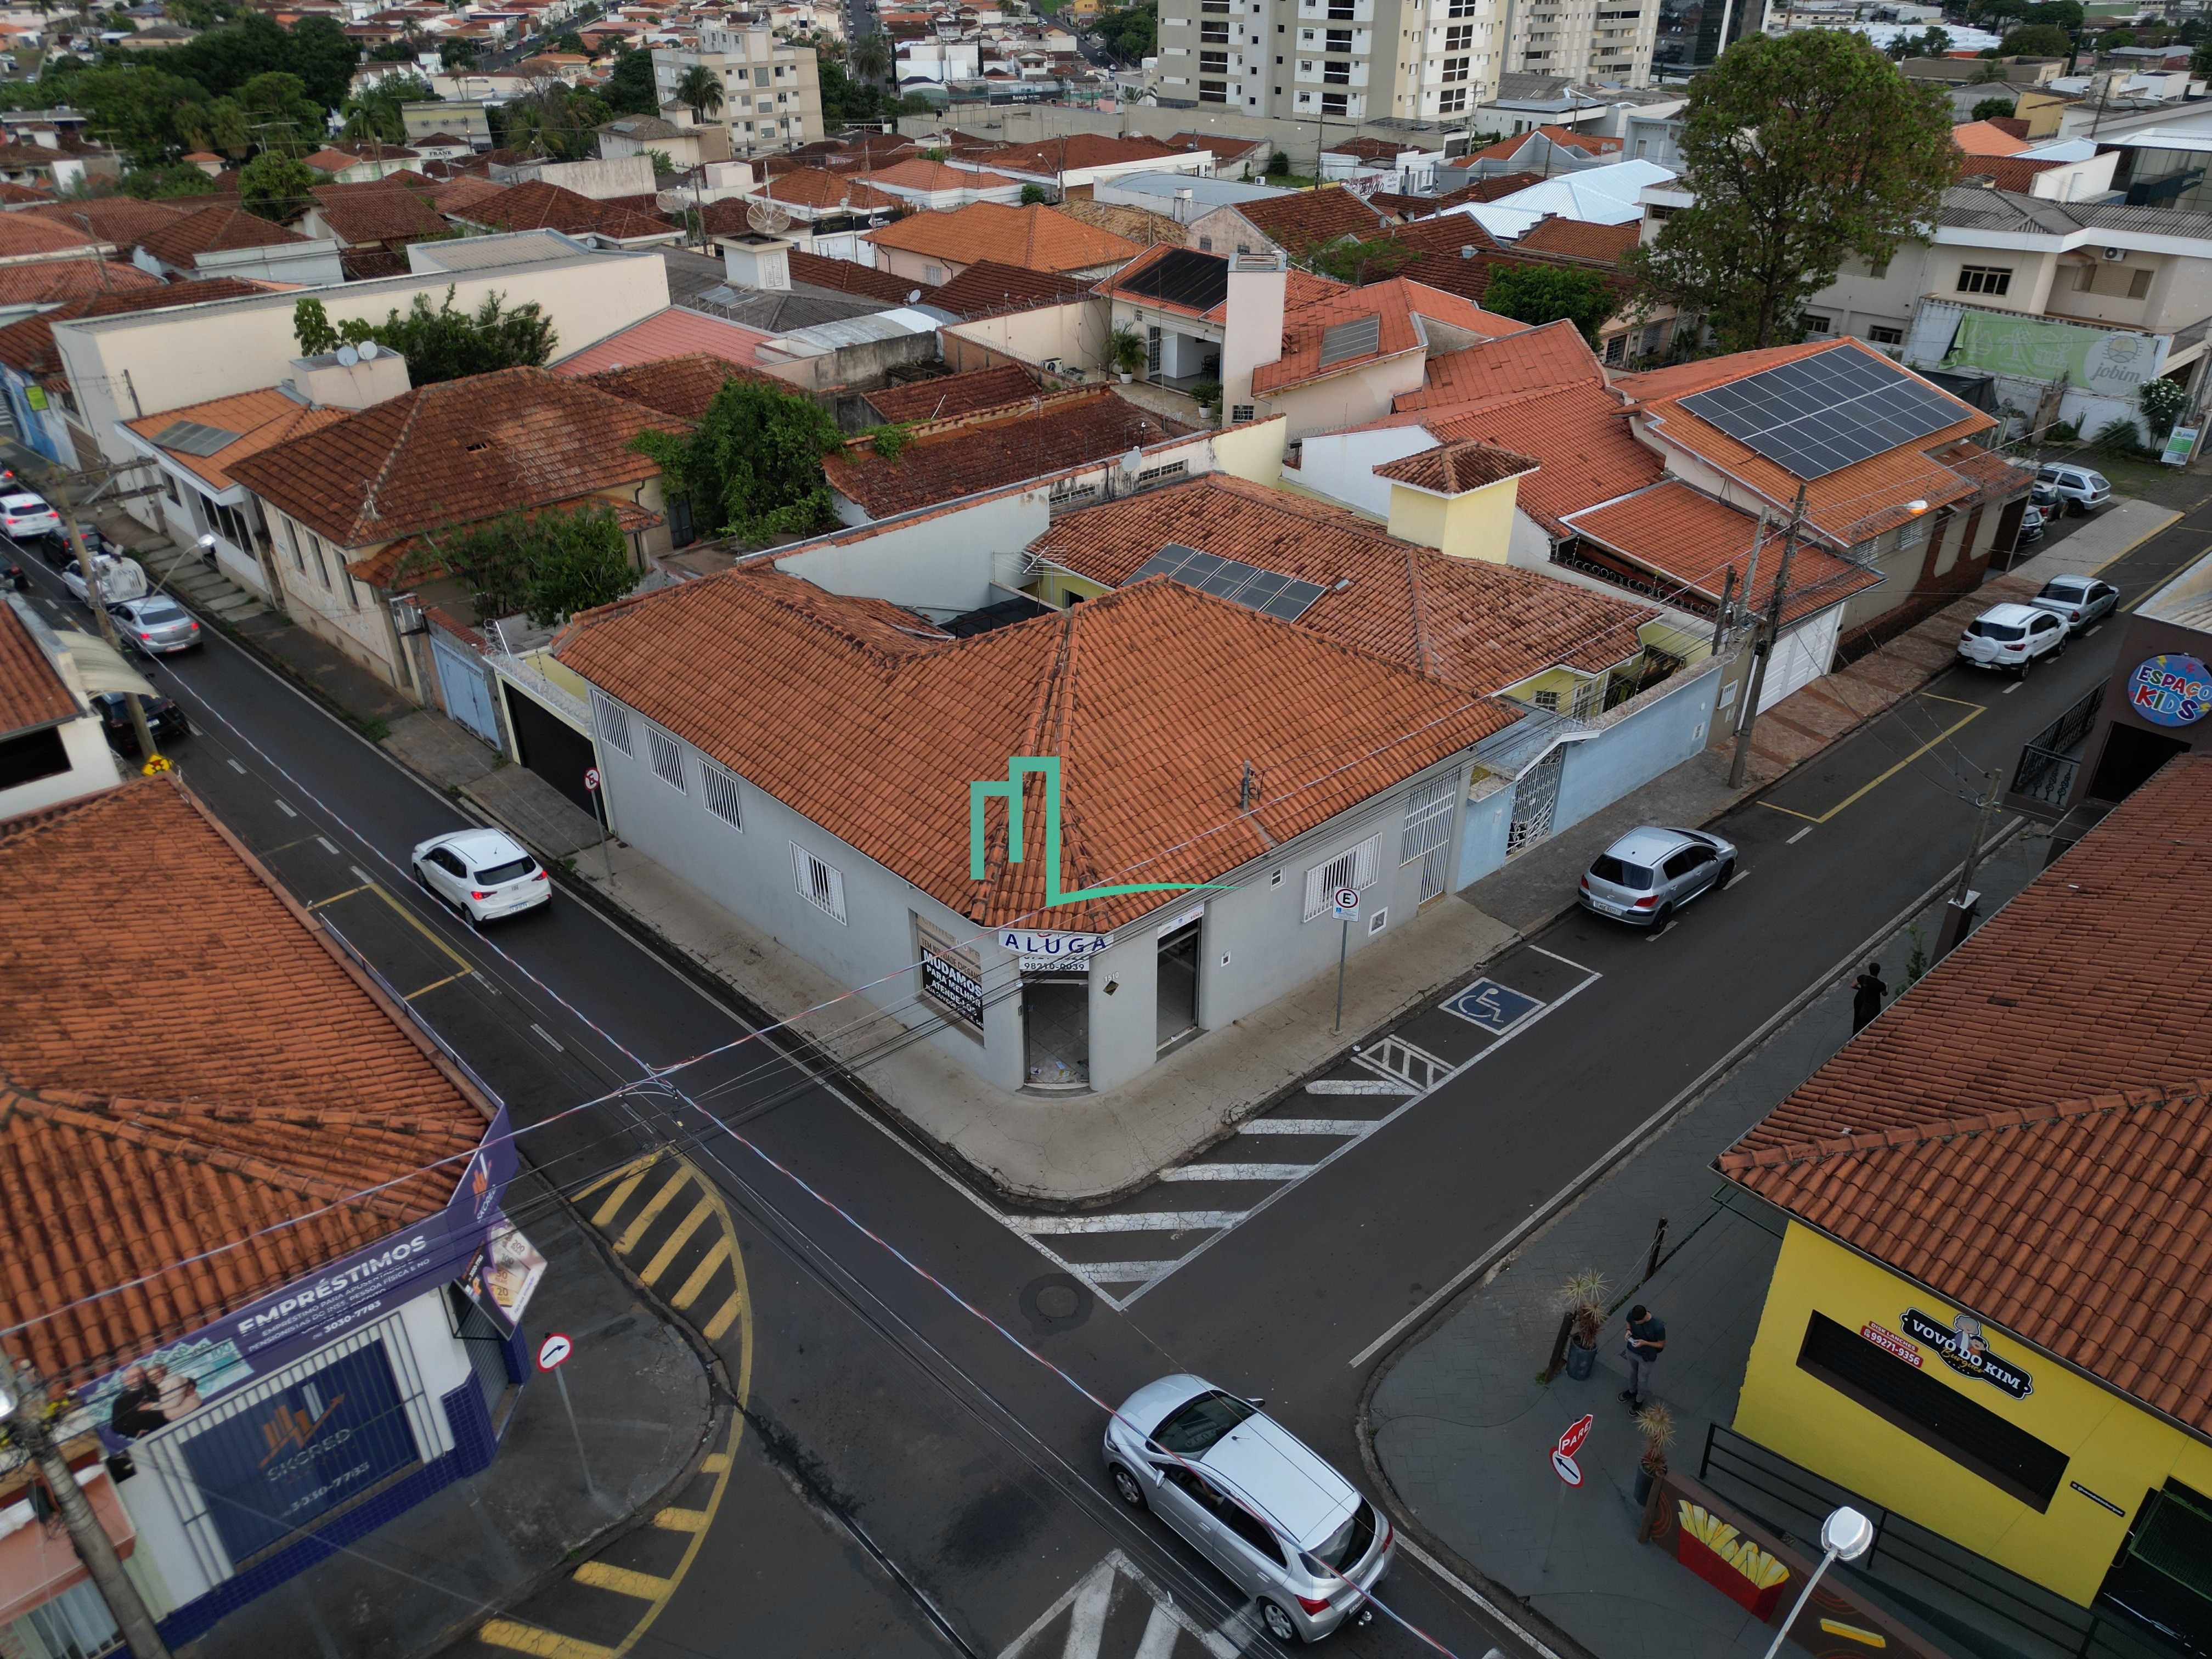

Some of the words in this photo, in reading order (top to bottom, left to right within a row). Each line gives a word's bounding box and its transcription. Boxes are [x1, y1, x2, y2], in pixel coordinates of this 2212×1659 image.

[2089, 362, 2140, 383] jobim
[2137, 665, 2212, 701] ESPAÇO
[2134, 684, 2200, 720] KIDS
[1342, 893, 1351, 904] E
[1005, 934, 1106, 953] ALUGA
[922, 938, 932, 950] TEM
[957, 962, 981, 983] CHEGAND
[923, 949, 982, 997] MUDAMOS
[927, 964, 947, 984] PARA
[949, 979, 981, 1007] MELHOR
[1104, 972, 1119, 982] 1510
[501, 1253, 514, 1265] 100
[512, 1239, 525, 1252] 200
[238, 1235, 426, 1337] EMPRÉSTIMOS
[312, 1311, 326, 1321] DO
[349, 1283, 382, 1301] PESSOA
[383, 1269, 409, 1285] FÍSICA
[417, 1259, 430, 1268] NO
[496, 1269, 508, 1279] 50
[497, 1288, 509, 1296] 20
[262, 1305, 319, 1336] EMPRÉSTIMO
[320, 1293, 345, 1307] PARA
[324, 1300, 381, 1333] 3030-7783
[1870, 1333, 1920, 1365] 99271-9356
[1871, 1323, 1886, 1333] DISK
[1887, 1332, 1916, 1351] LANCHES
[1913, 1319, 1956, 1351] VOVÓ
[1958, 1348, 1982, 1367] DO
[1984, 1362, 2021, 1390] KIM
[1562, 1420, 1590, 1451] PARE
